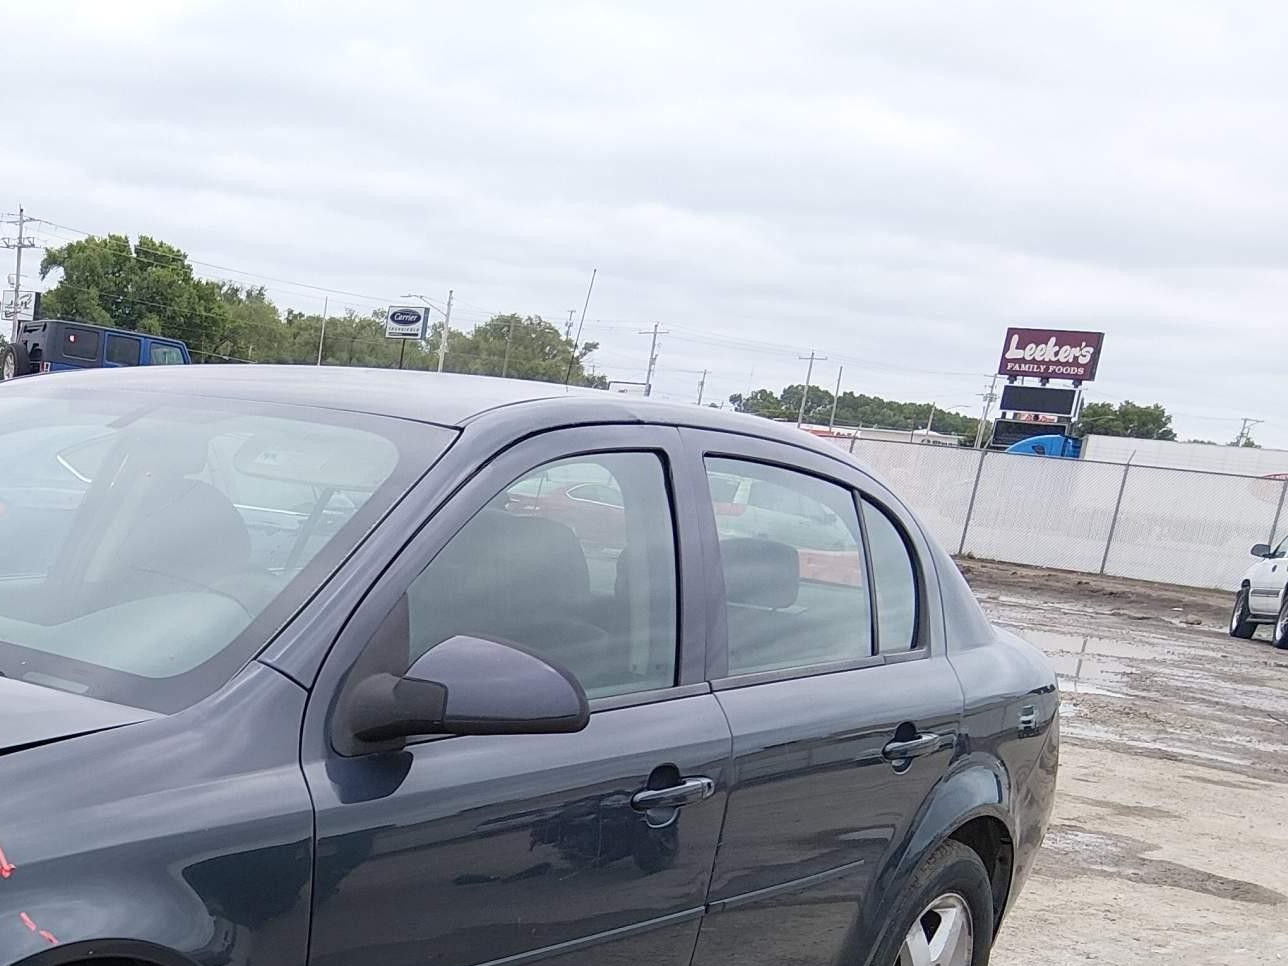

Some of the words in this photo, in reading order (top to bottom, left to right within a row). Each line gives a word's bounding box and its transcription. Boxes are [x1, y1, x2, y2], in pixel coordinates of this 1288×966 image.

[394, 312, 418, 322] Carrier
[1005, 334, 1094, 364] Leeker's
[1006, 362, 1047, 373] FAMILY
[1048, 365, 1085, 375] FOODS
